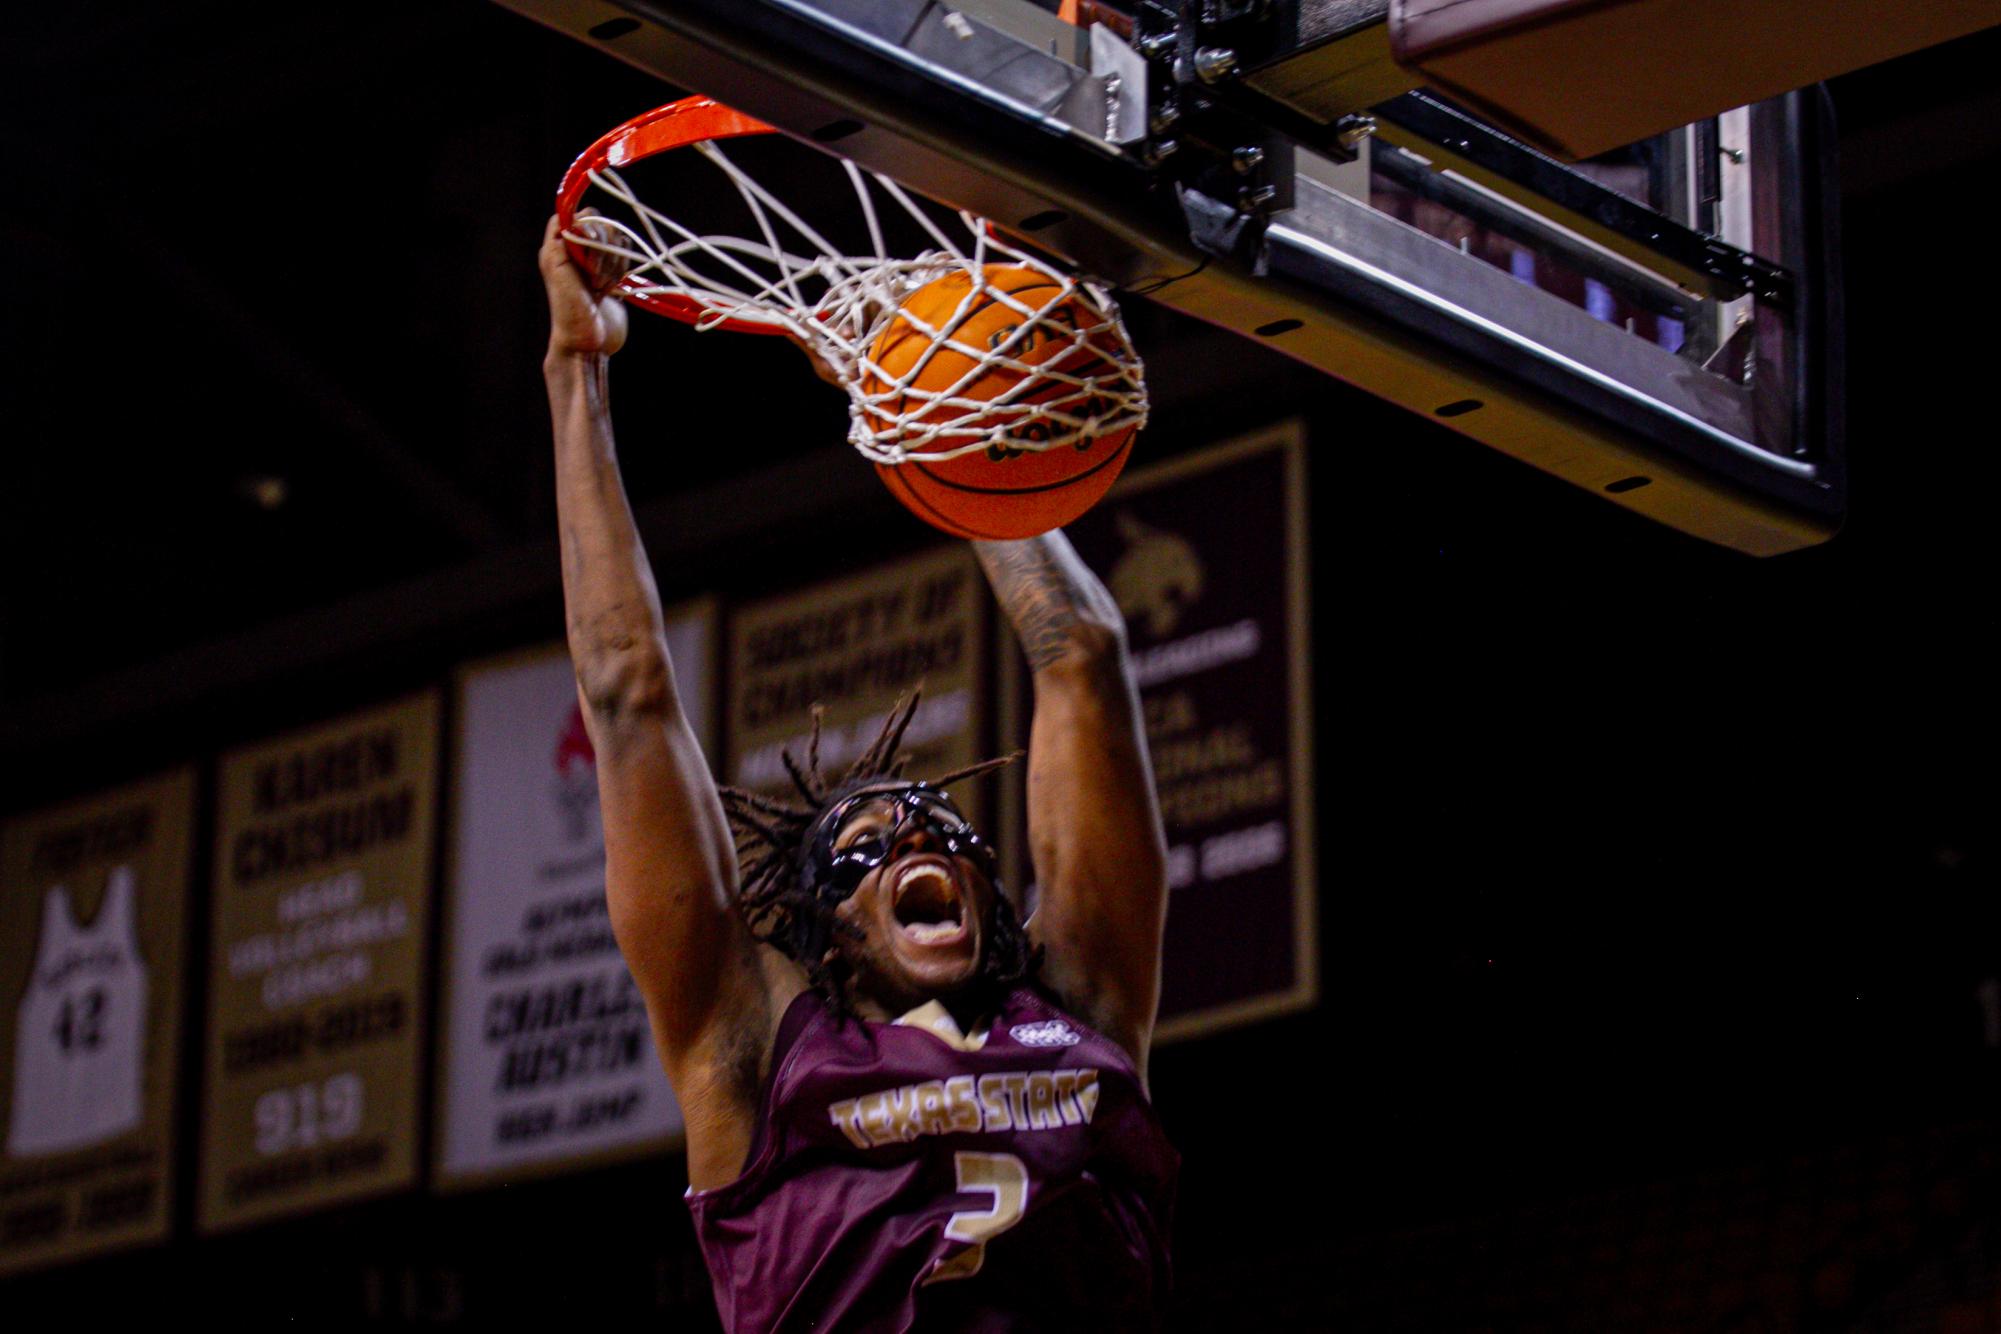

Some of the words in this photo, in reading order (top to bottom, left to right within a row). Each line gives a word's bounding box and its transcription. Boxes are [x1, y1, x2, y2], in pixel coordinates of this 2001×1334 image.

[484, 968, 650, 1040] CHARLE
[253, 1072, 366, 1157] 919
[828, 1074, 982, 1149] TEXAS
